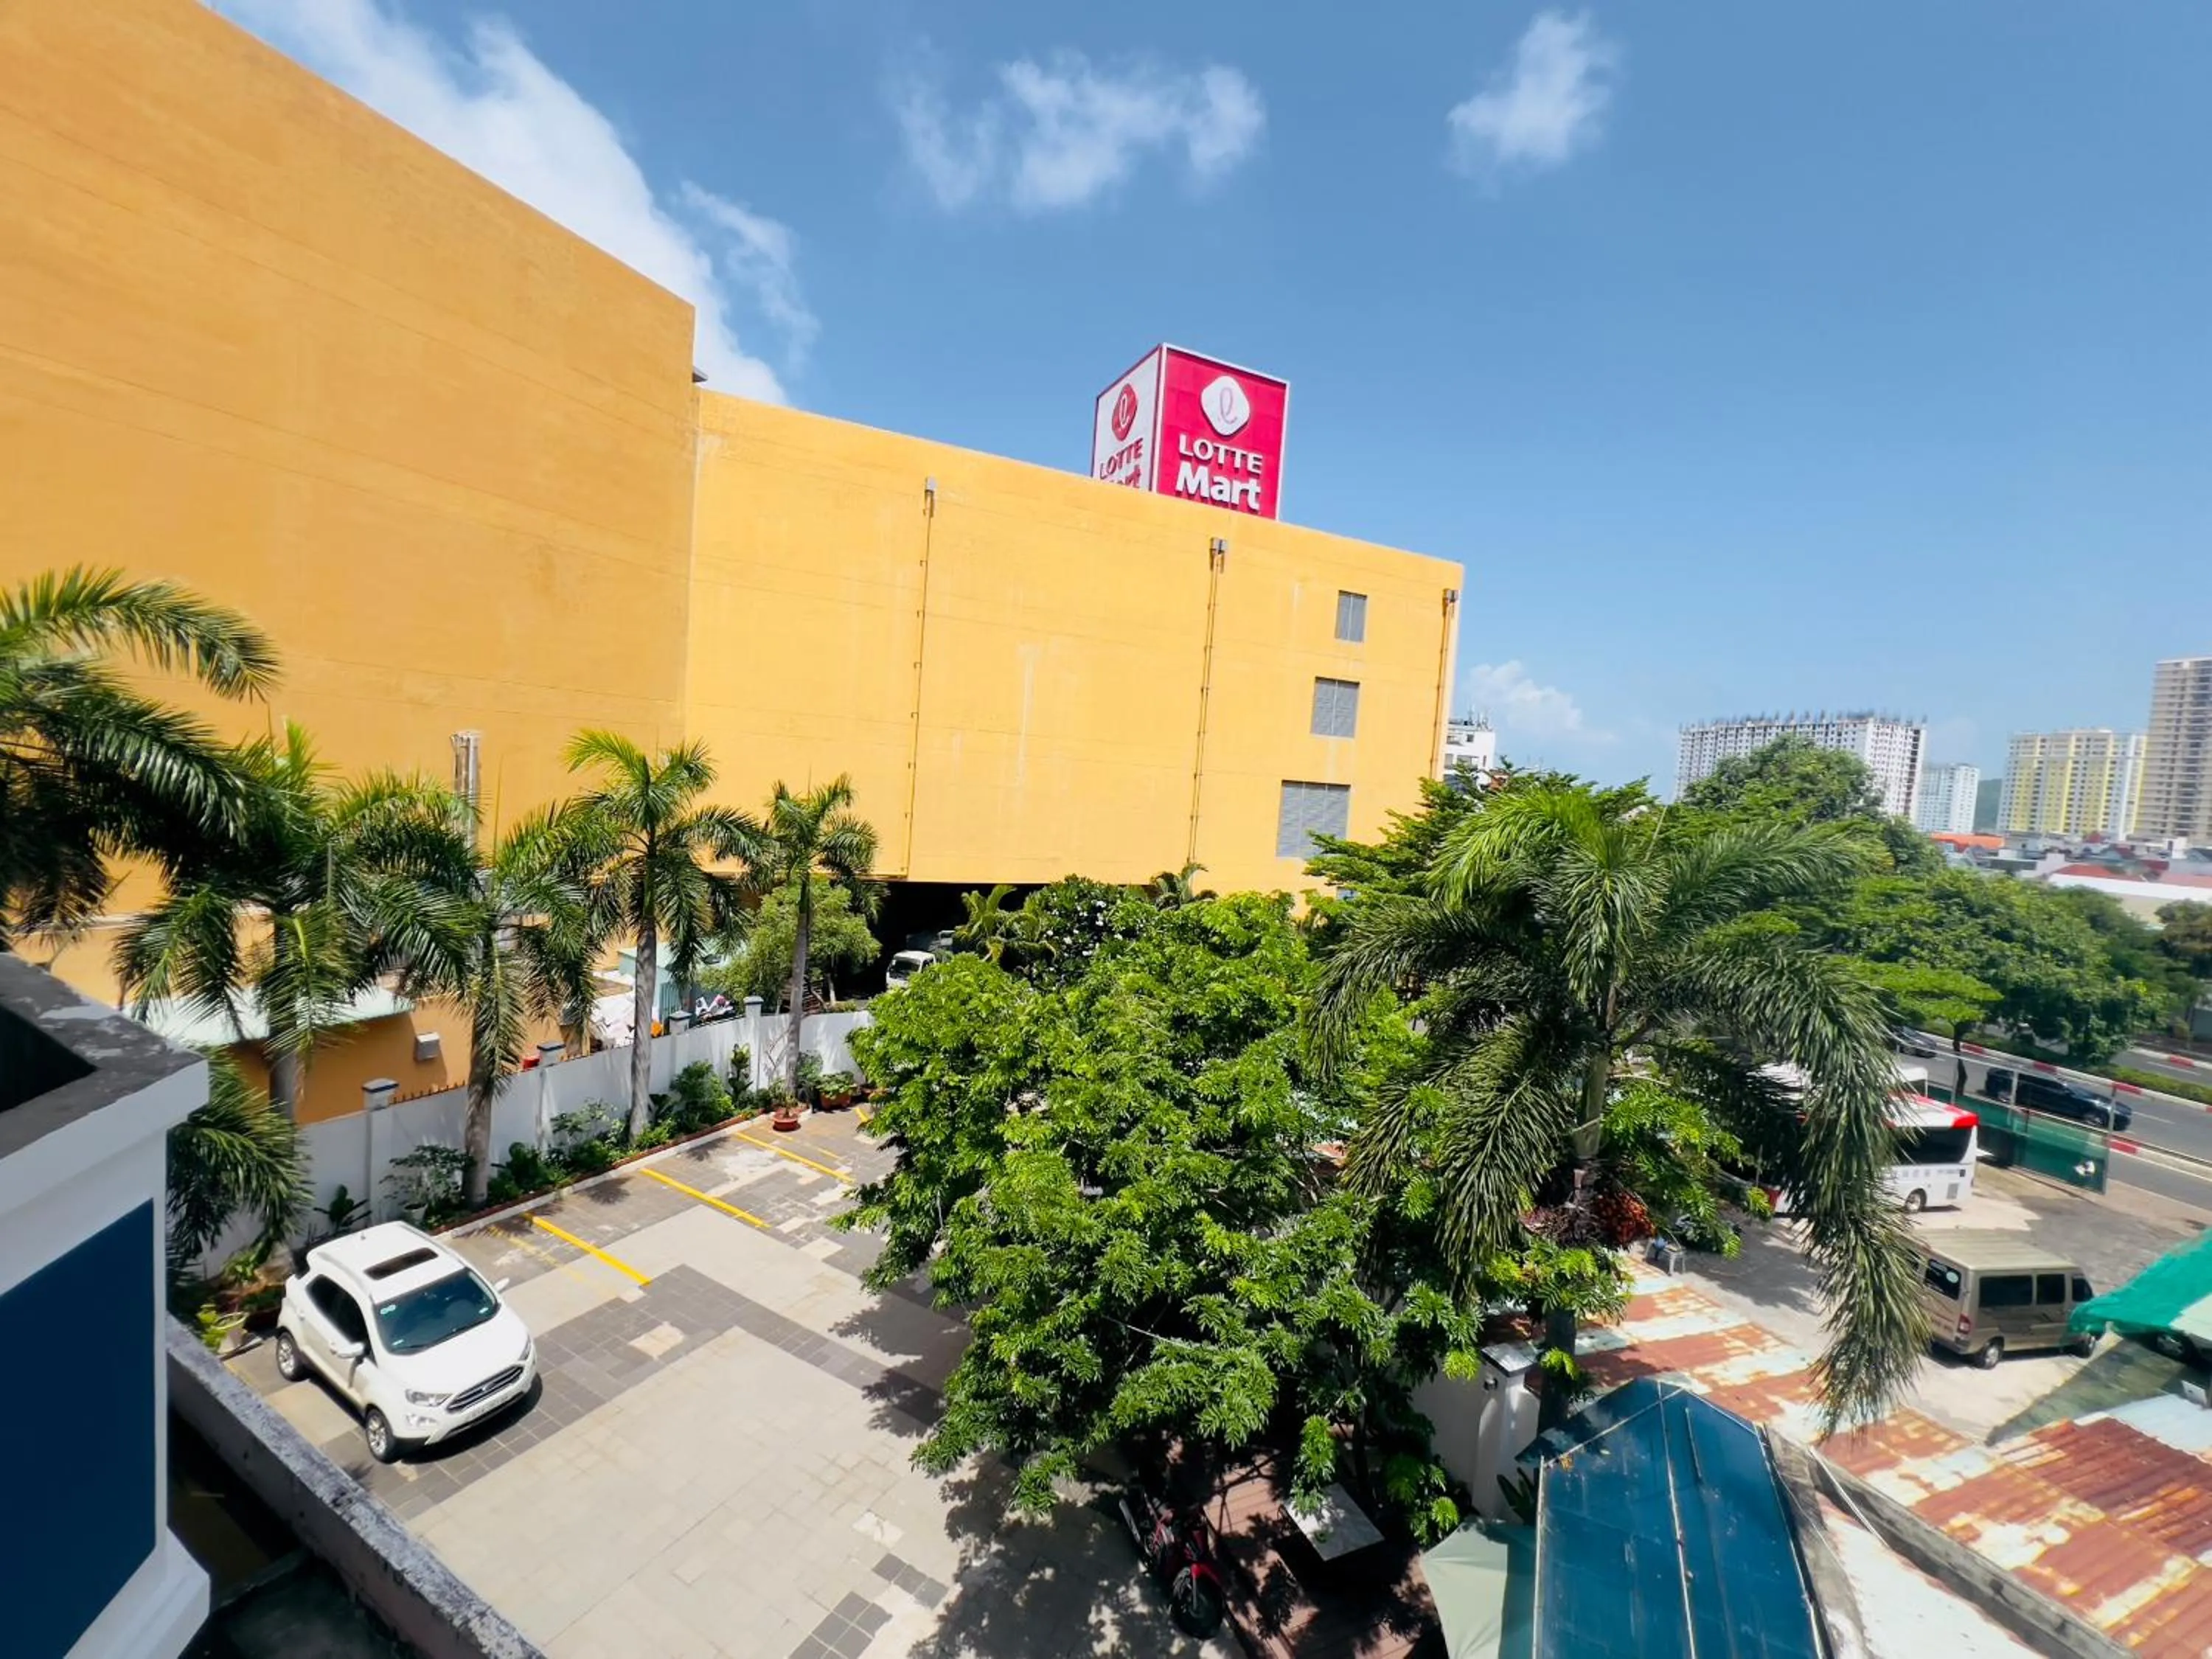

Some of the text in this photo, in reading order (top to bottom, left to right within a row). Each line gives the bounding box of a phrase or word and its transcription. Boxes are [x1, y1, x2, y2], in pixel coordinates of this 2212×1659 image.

[1099, 437, 1143, 479] LOTTE
[1179, 433, 1263, 474] LOTTE
[1109, 464, 1141, 488] rt
[1175, 461, 1261, 510] Mart
